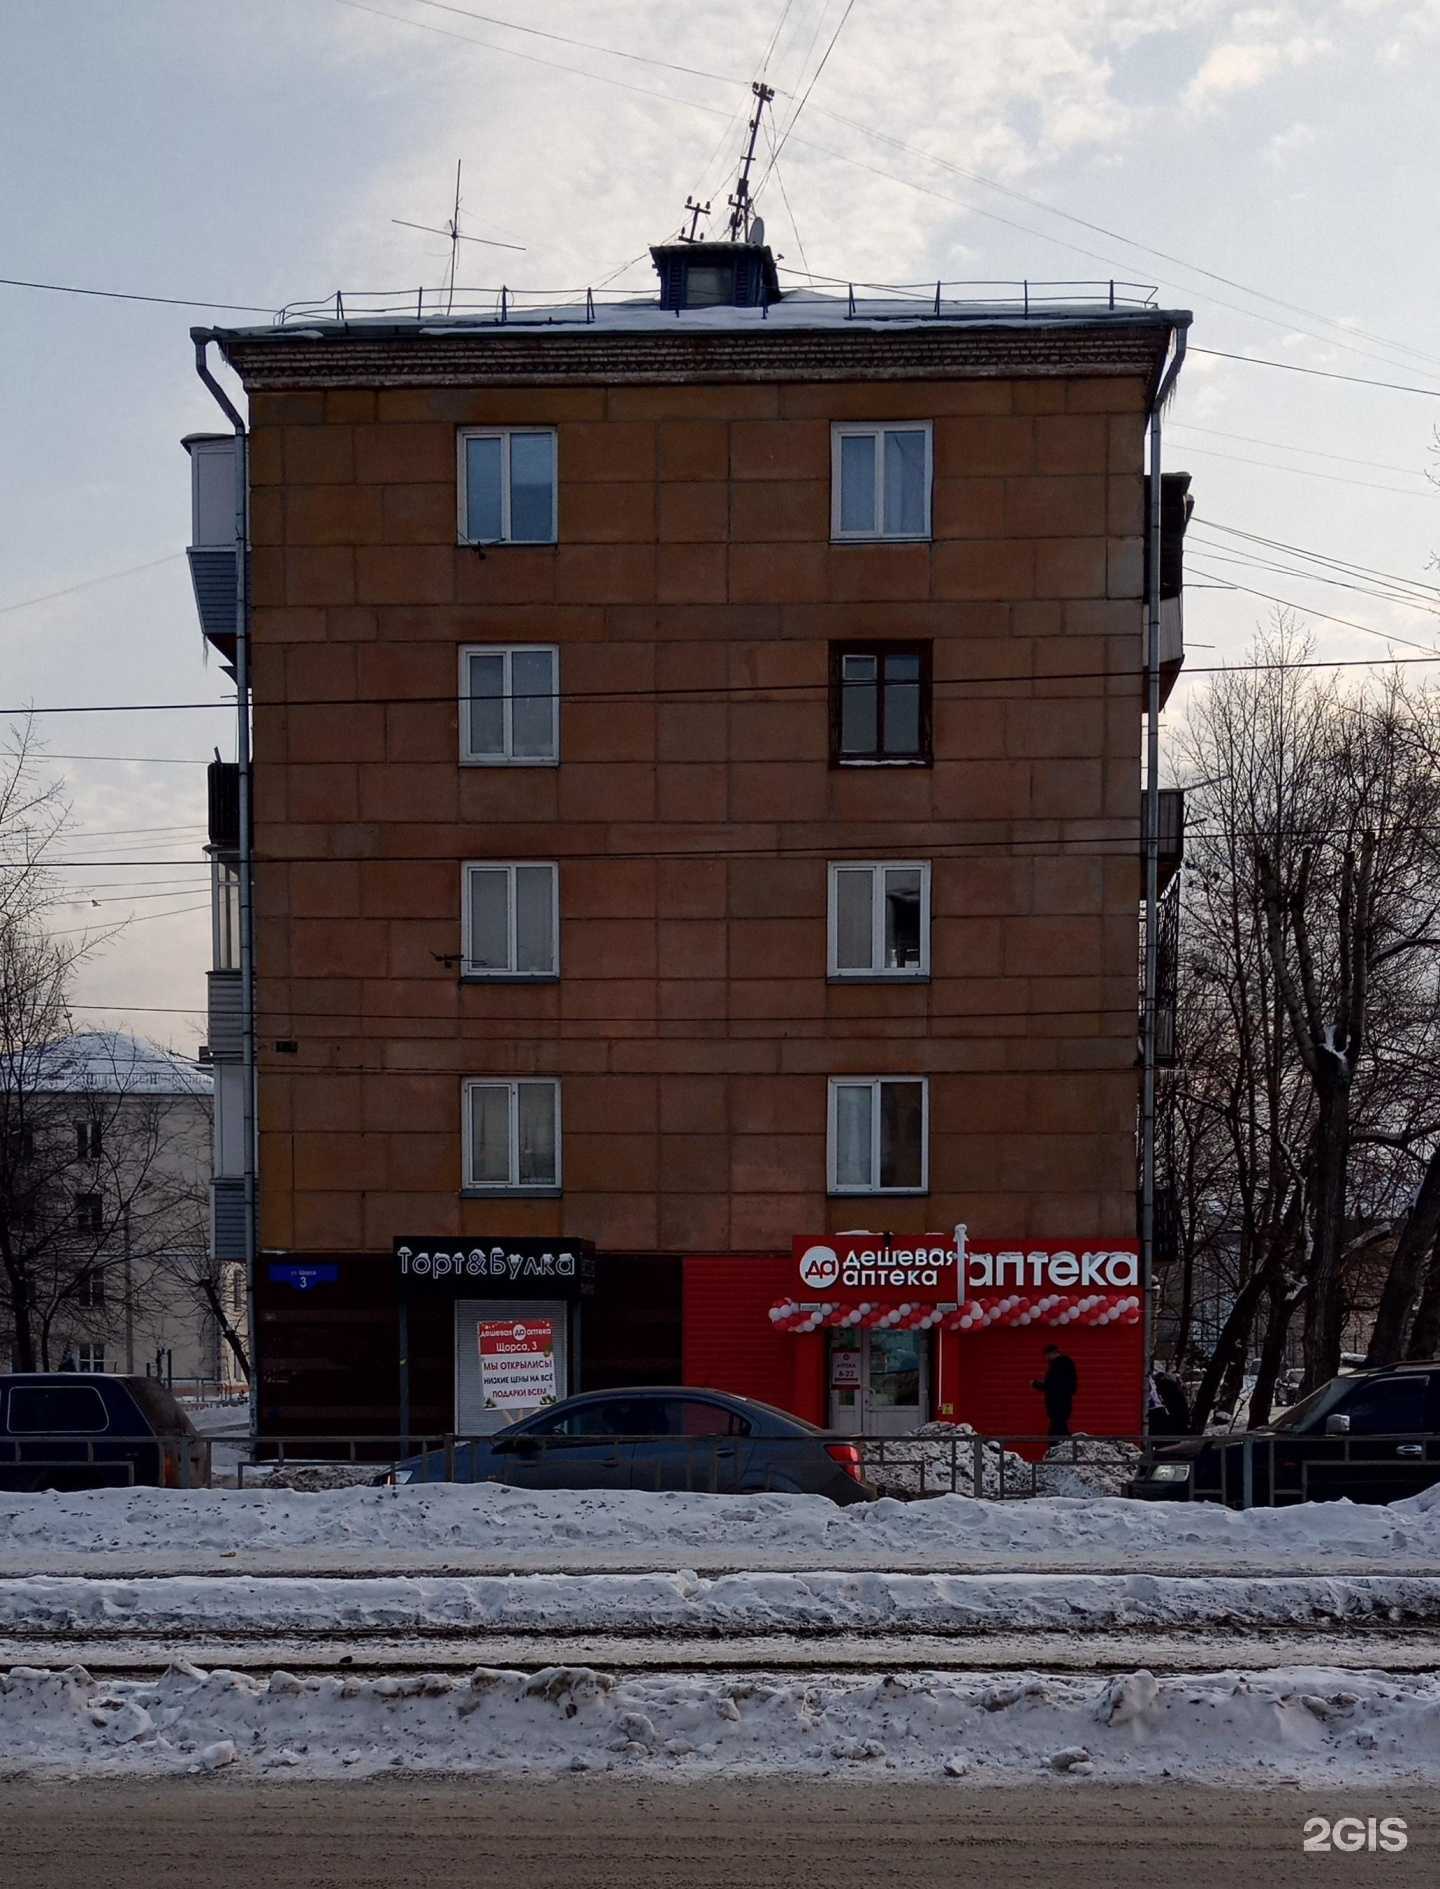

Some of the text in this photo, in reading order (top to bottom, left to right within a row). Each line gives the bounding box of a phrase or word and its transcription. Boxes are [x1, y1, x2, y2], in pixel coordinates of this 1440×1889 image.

[397, 1246, 576, 1279] Торт&Булка
[968, 1250, 1139, 1287] аптека
[299, 1276, 308, 1288] 3
[842, 1267, 938, 1286] аптека
[483, 1362, 498, 1371] МЫ
